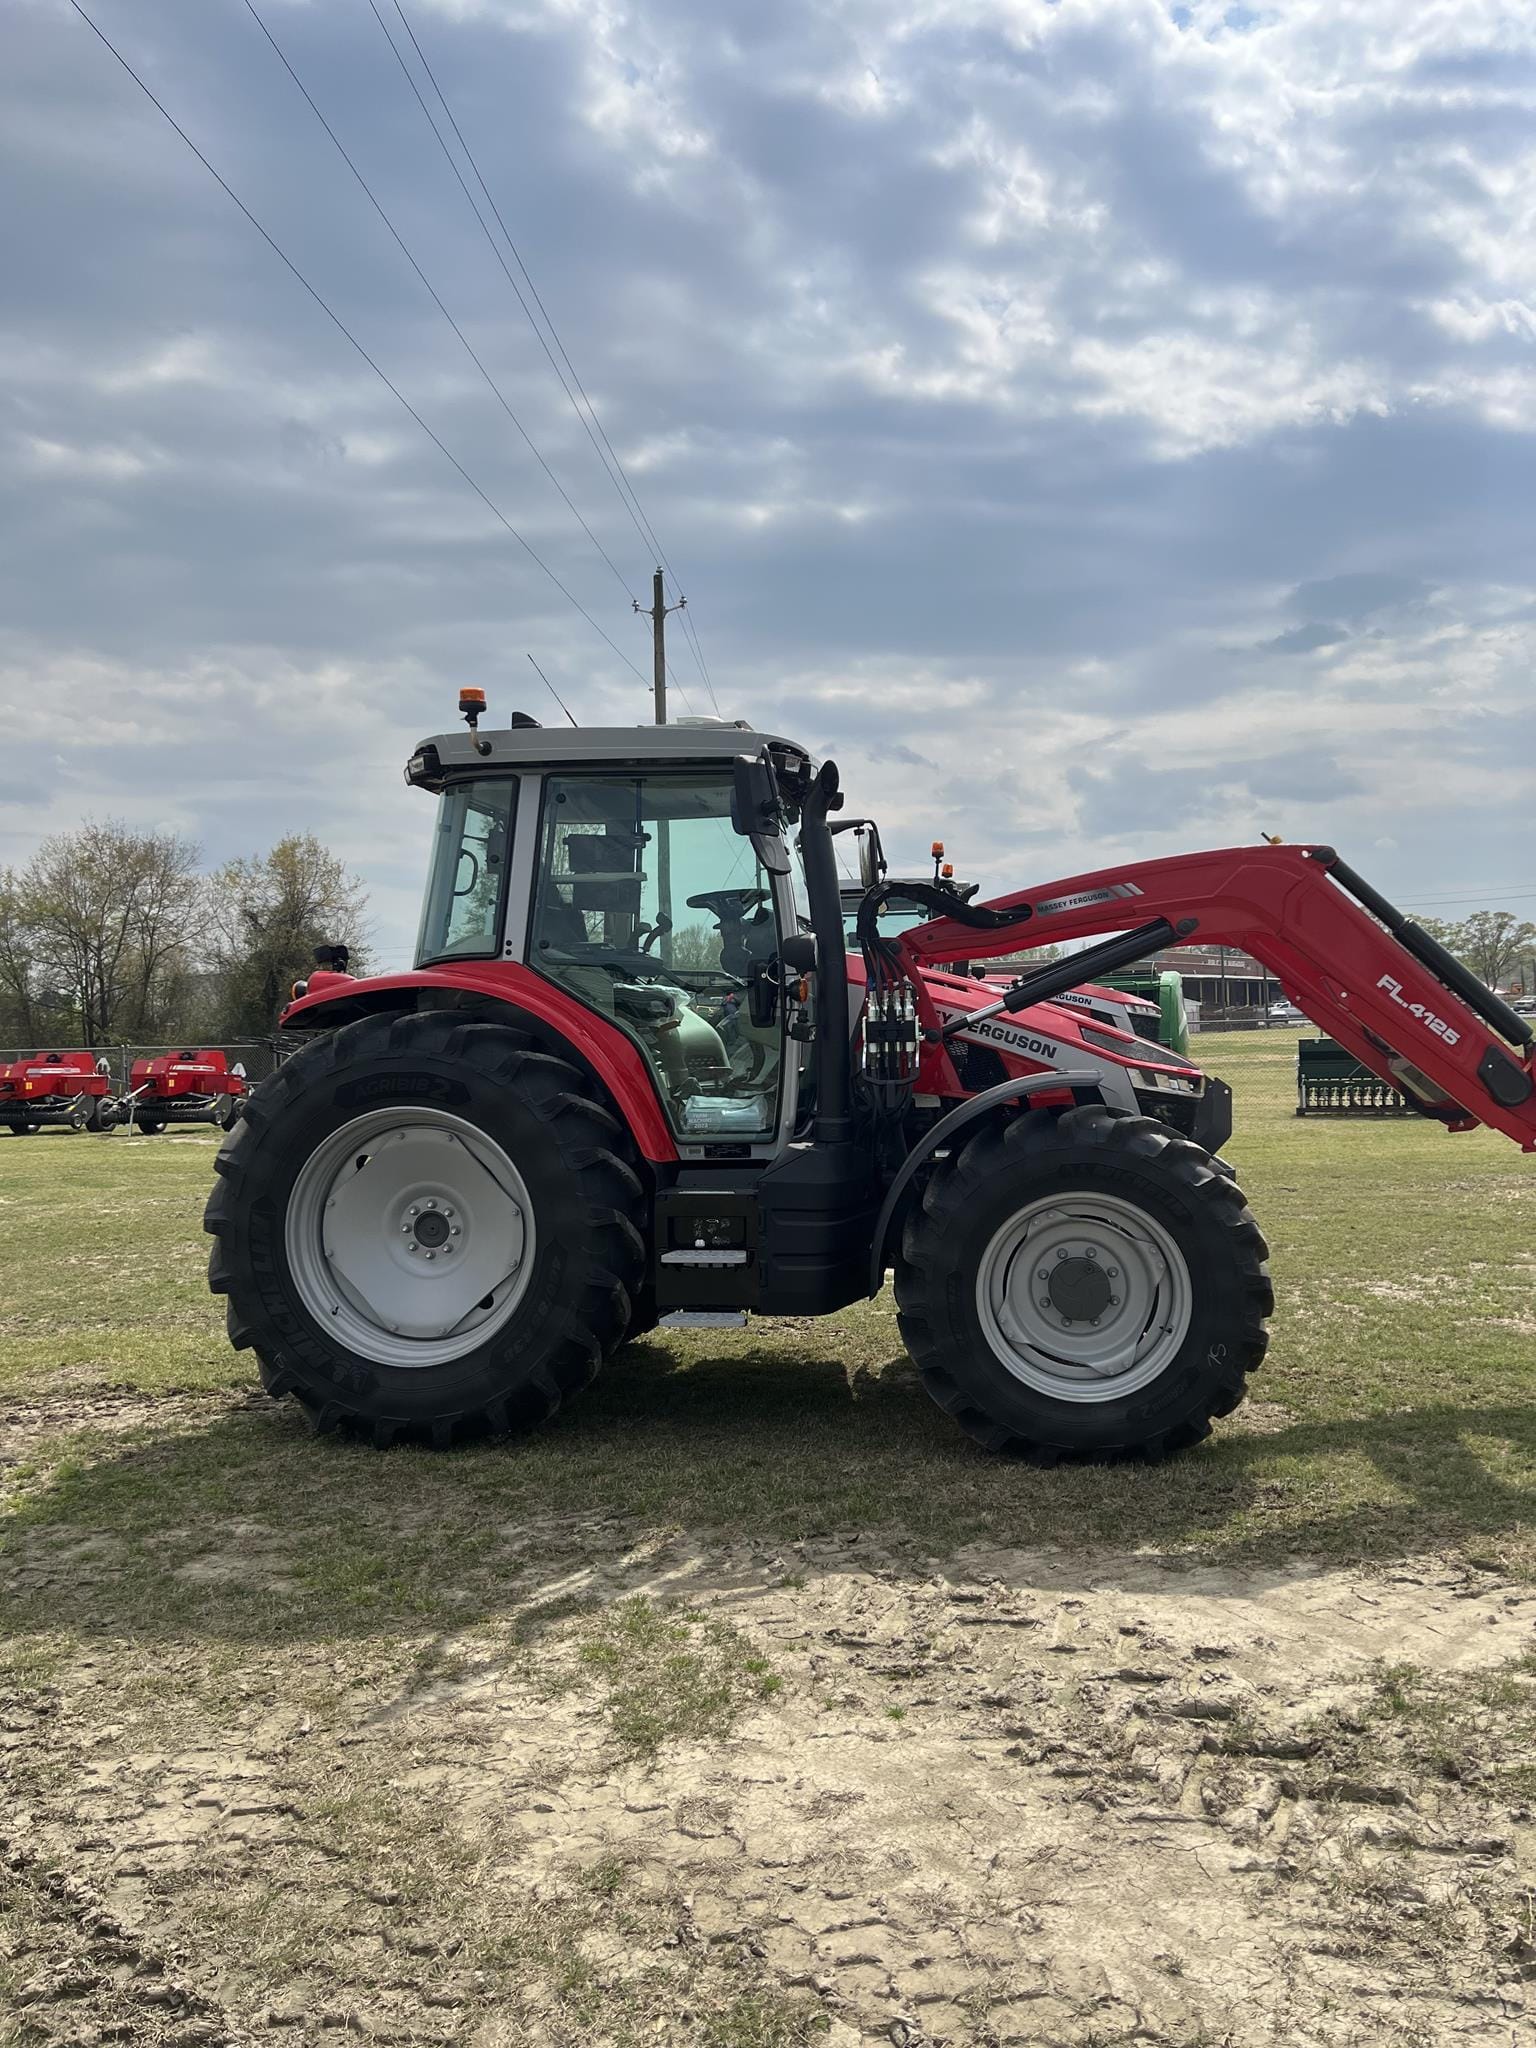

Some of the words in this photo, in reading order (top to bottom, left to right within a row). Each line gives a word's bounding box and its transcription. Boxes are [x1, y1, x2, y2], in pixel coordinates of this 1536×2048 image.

[1037, 900, 1067, 913] MASSEY
[1068, 891, 1109, 906] FERGUSON
[1056, 993, 1092, 1006] GUSON
[1376, 974, 1461, 1045] FL.4125
[967, 1020, 1058, 1059] ERGUSON
[249, 1211, 333, 1375] MICHELIN
